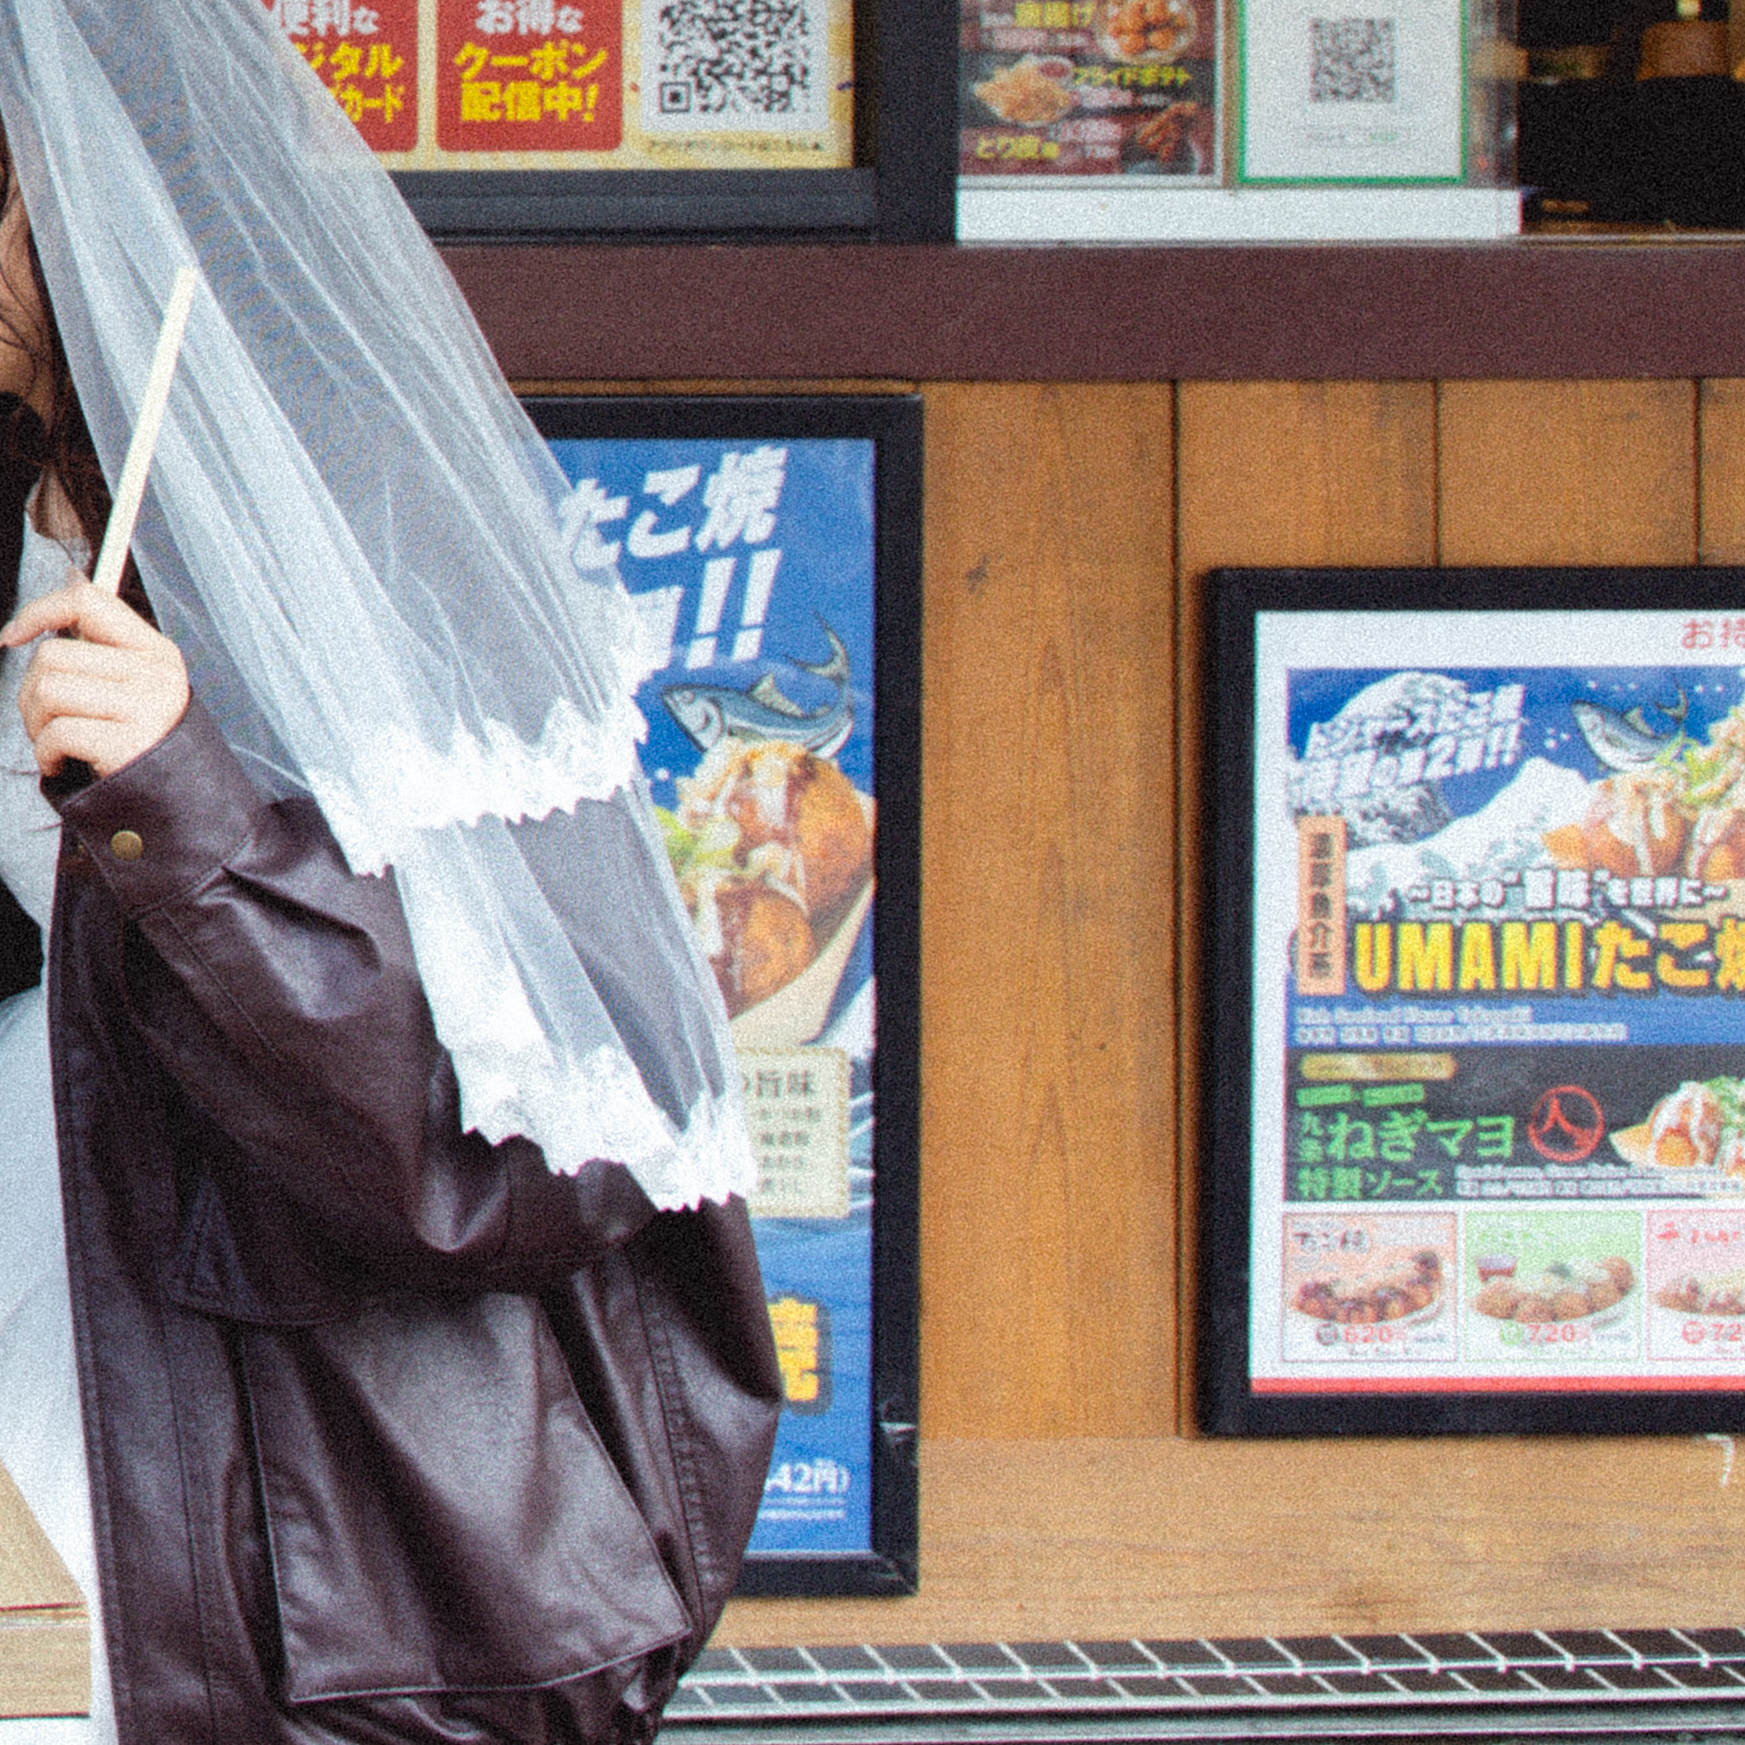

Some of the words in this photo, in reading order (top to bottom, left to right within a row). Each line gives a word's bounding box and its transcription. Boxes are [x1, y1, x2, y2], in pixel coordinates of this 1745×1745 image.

[453, 40, 608, 81] クーポン
[459, 82, 599, 123] 配信中!
[559, 445, 789, 570] たこ焼
[742, 1068, 816, 1098] 旨味
[1297, 1165, 1444, 1200] 特製ソース
